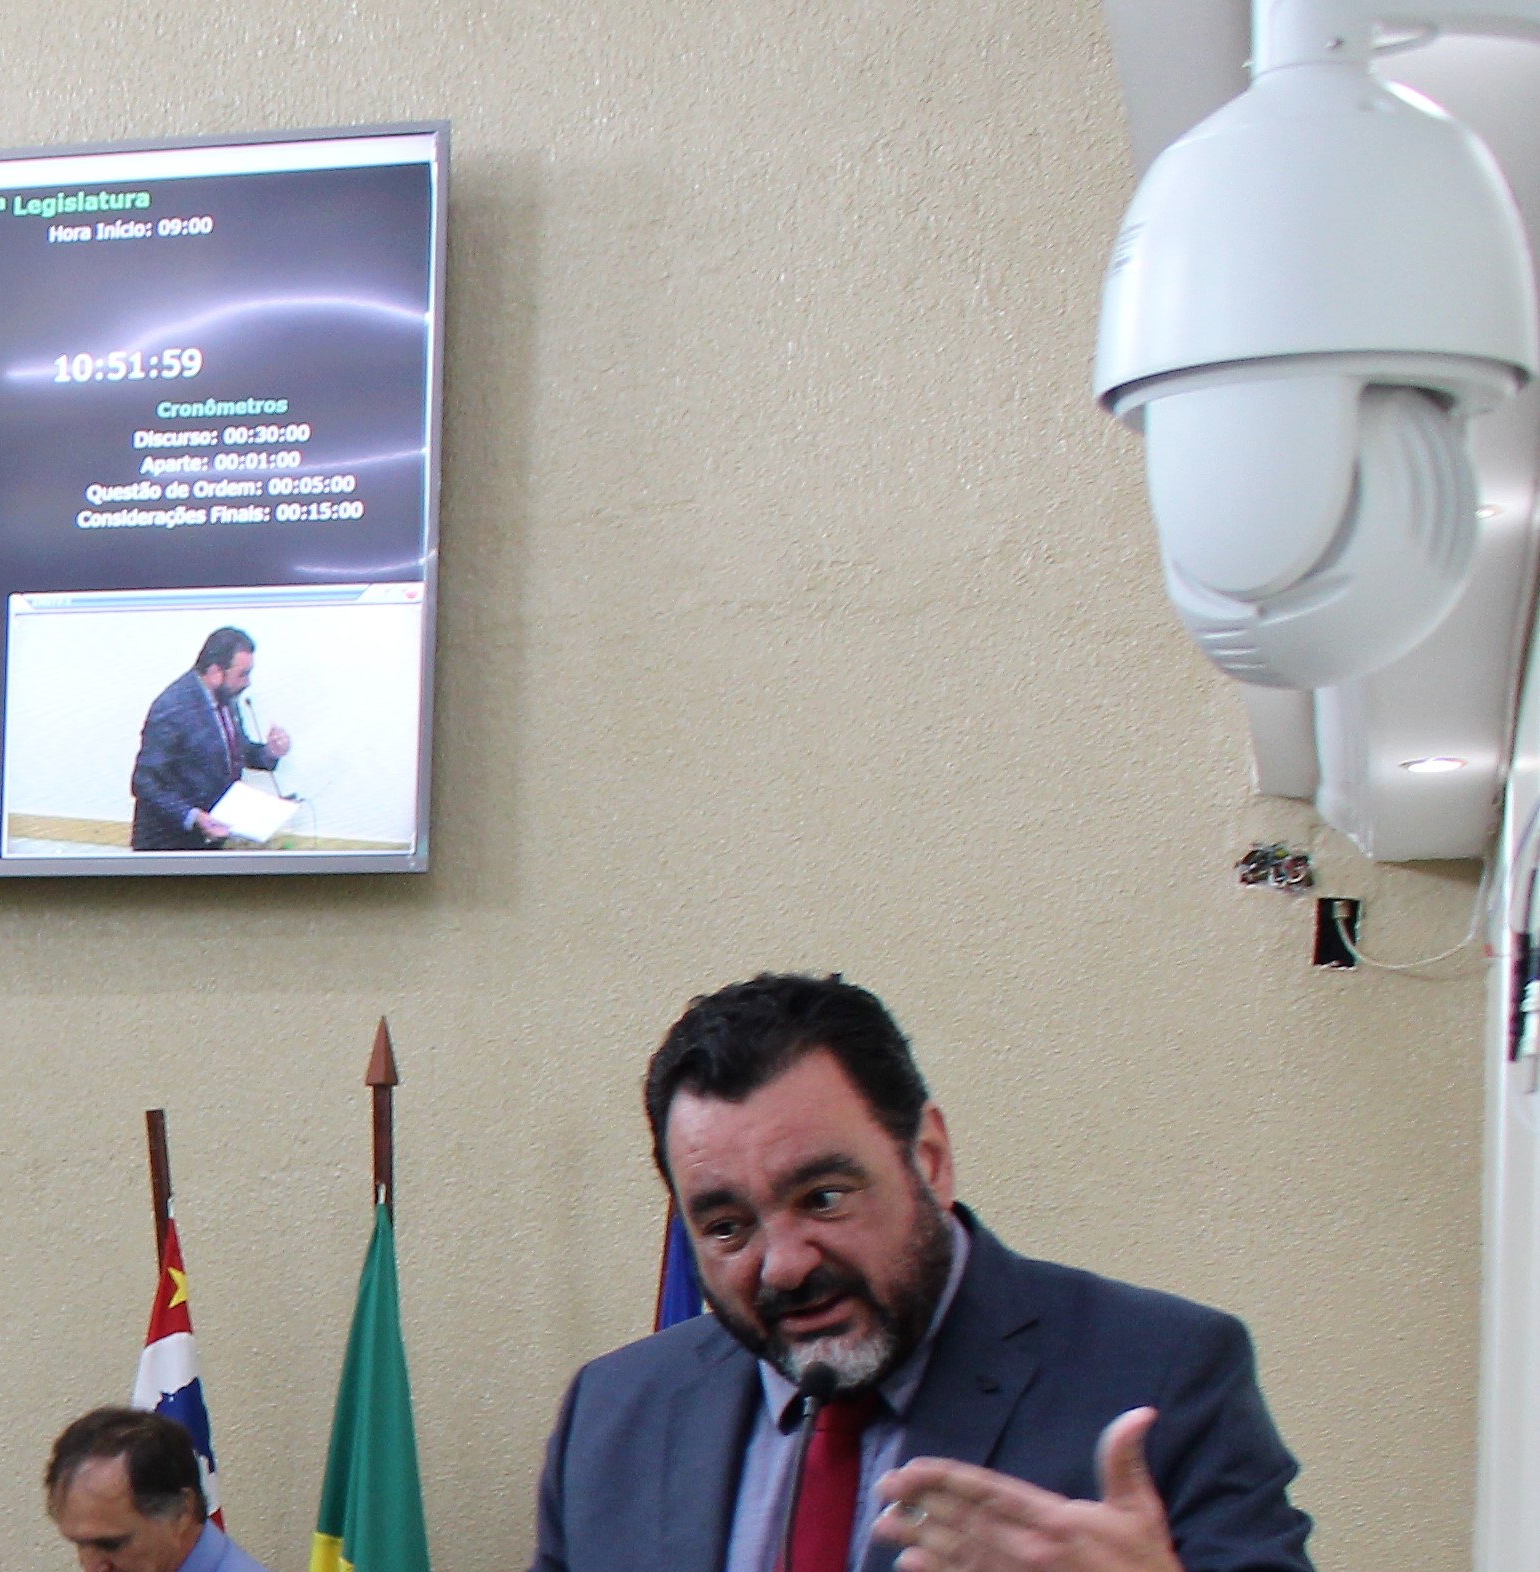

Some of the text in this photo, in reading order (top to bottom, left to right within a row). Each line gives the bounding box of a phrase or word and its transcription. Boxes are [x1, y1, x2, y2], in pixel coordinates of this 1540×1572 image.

[14, 190, 150, 218] Legislatura
[49, 216, 212, 243] Hora Início: 09:00
[54, 348, 202, 382] 10:51:59
[157, 397, 287, 418] Cronômetros
[133, 423, 310, 448] Discurso: 00:30:00
[140, 451, 301, 476] Aparte: 00:01:00
[86, 476, 356, 503] Questão de Ordem: 00:05:00
[76, 501, 364, 528] Considerações Finais: 00:15:00
